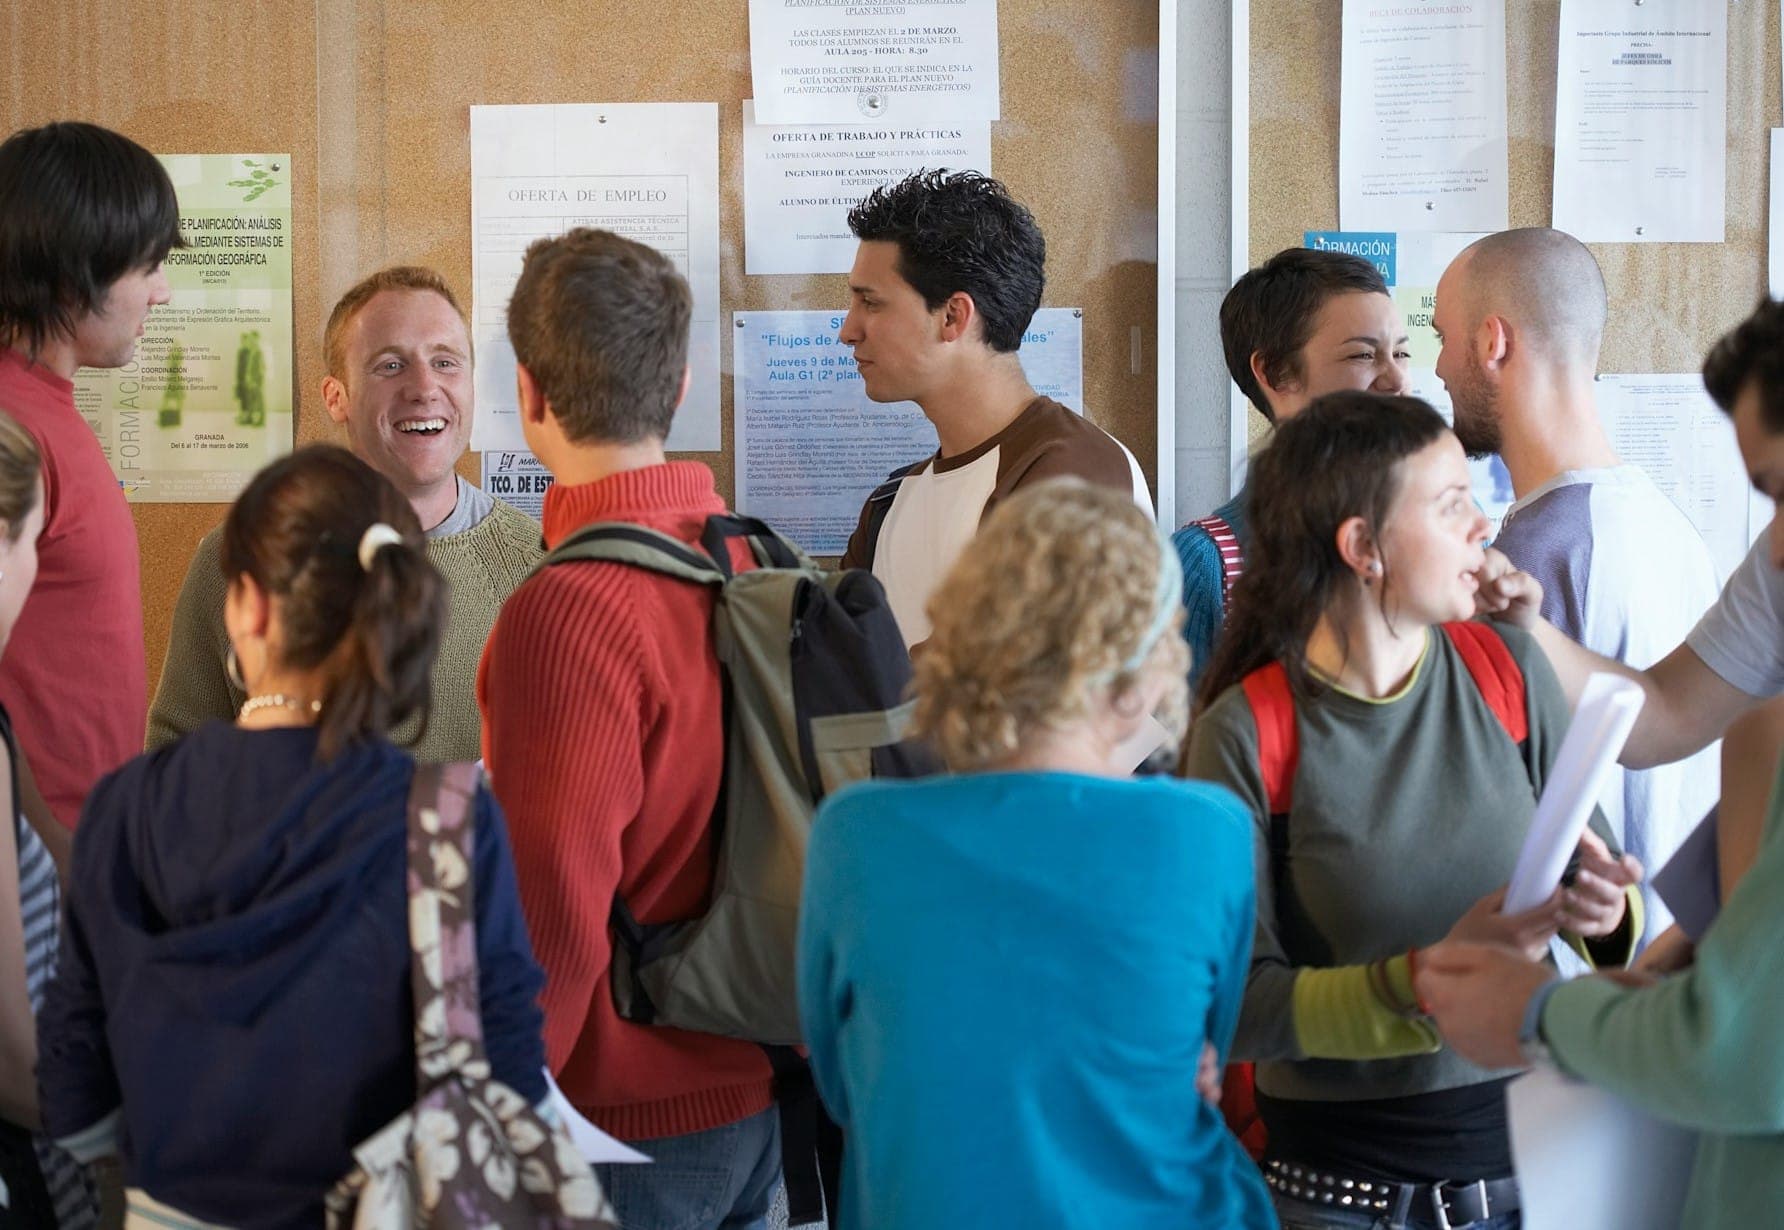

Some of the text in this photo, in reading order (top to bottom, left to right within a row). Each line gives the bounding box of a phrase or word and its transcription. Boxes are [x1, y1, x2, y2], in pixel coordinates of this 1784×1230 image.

[845, 7, 906, 16] (PLAN NUEVO)
[793, 30, 808, 38] LAS
[843, 29, 886, 37] EMPIEZAN
[888, 28, 899, 36] EL
[923, 27, 959, 35] MARZO.
[789, 39, 818, 47] TODOS
[838, 37, 879, 46] ALUMNOS
[881, 37, 892, 45] SE
[824, 48, 850, 56] AULA
[851, 48, 868, 57] 205
[875, 47, 906, 55] HORA:
[909, 46, 929, 55] 8.30
[781, 67, 821, 76] HORARIO
[840, 65, 870, 74] CURSO:
[872, 65, 884, 73] EL
[884, 65, 903, 75] QUE
[905, 65, 916, 73] SE
[917, 64, 947, 73] INDICA
[948, 64, 961, 72] EN
[962, 64, 974, 72] LA
[800, 76, 822, 85] GUÍA
[823, 76, 863, 84] DOCENTE
[864, 75, 887, 83] PARA
[888, 75, 900, 83] EL
[924, 74, 955, 82] NUEVO
[784, 84, 851, 95] (PLANIFICACIÓN
[865, 84, 908, 93] SISTEMAS
[773, 127, 963, 143] OFERTA DE TRABAJO Y PRÁCTICAS
[777, 152, 810, 160] EMPRESA
[811, 151, 854, 159] GRANADINA
[877, 150, 910, 158] SOLICITA
[912, 149, 930, 157] PARA
[785, 170, 833, 179] INGENIERO
[836, 169, 847, 177] DE
[848, 168, 888, 177] CAMINOS
[889, 168, 907, 176] CON
[508, 188, 667, 202] OFERTA DE EMPLEO
[780, 199, 816, 207] ALUMNO
[818, 198, 831, 206] DE
[188, 215, 246, 231] PLANIFICACIÓN:
[248, 215, 282, 230] ANÁLISIS
[600, 217, 646, 225] ASISTENCIA
[195, 236, 233, 248] MEDIANTE
[235, 236, 272, 248] SISTEMAS
[274, 236, 284, 248] DE
[217, 250, 267, 266] GEOGRÁFICA
[206, 269, 231, 277] EDICIÓN
[196, 307, 227, 315] Ordenación
[187, 316, 214, 325] Expresión
[214, 316, 233, 324] Gráfica
[234, 316, 271, 325] Arquitectónica
[141, 337, 174, 345] DIRECCIÓN
[762, 334, 810, 349] "Flujos
[816, 334, 832, 346] de
[141, 346, 166, 354] Alejandro
[153, 354, 171, 363] Miguel
[767, 357, 807, 367] Jueves
[811, 356, 818, 366] 9
[821, 355, 835, 366] de
[141, 366, 187, 375] COORDINACIÓN
[769, 370, 795, 381] Aula
[799, 370, 814, 380] G1
[817, 369, 834, 383] (2ª
[194, 434, 225, 442] GRANADA
[491, 475, 515, 494] TCO.
[518, 475, 532, 494] DE
